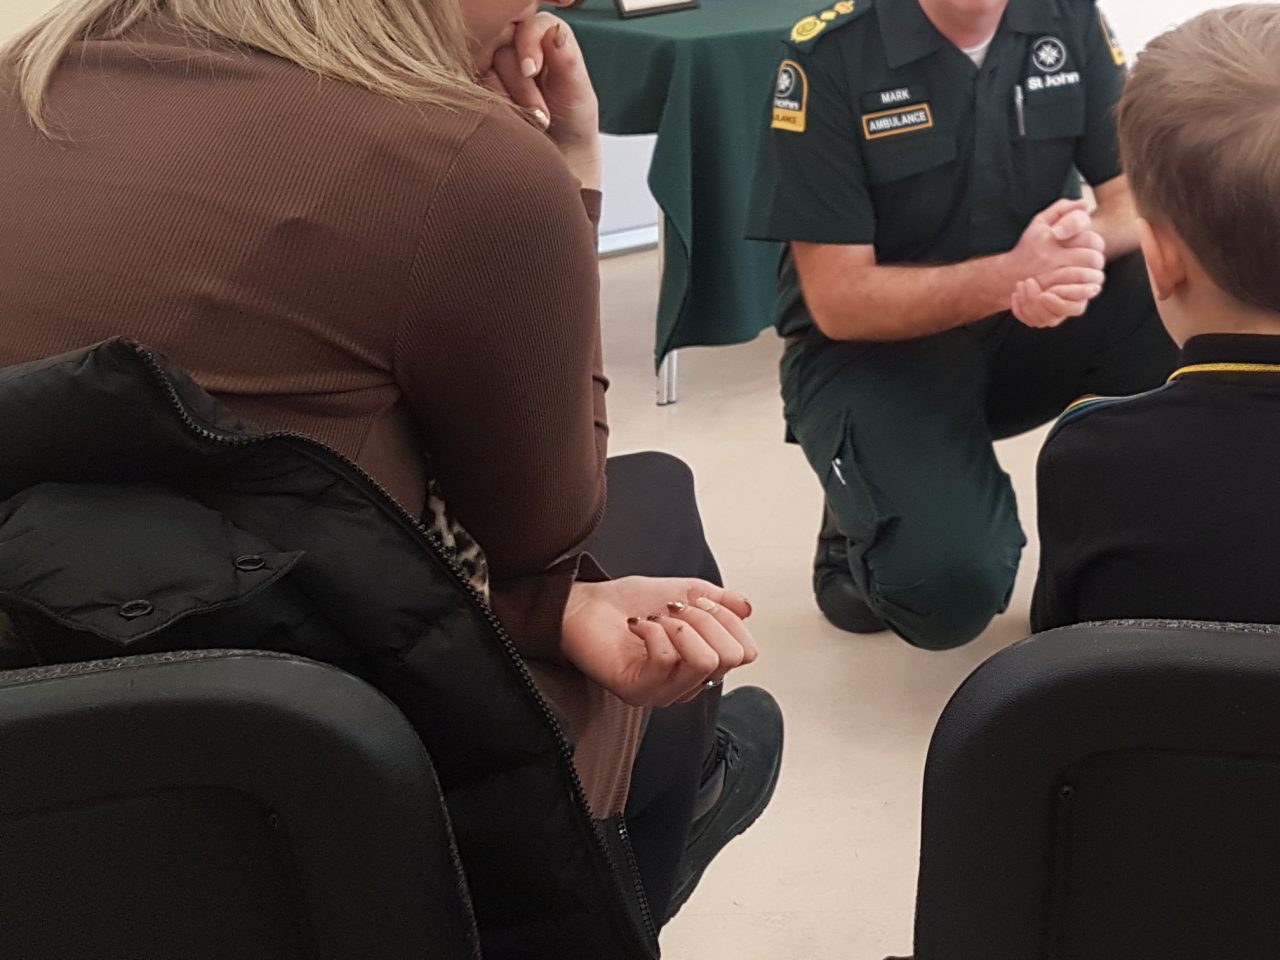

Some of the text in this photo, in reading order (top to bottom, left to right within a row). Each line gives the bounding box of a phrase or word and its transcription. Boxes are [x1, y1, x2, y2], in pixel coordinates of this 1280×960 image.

[1027, 72, 1080, 90] St John
[880, 89, 910, 104] MARK
[869, 110, 927, 132] AMBULANCE
